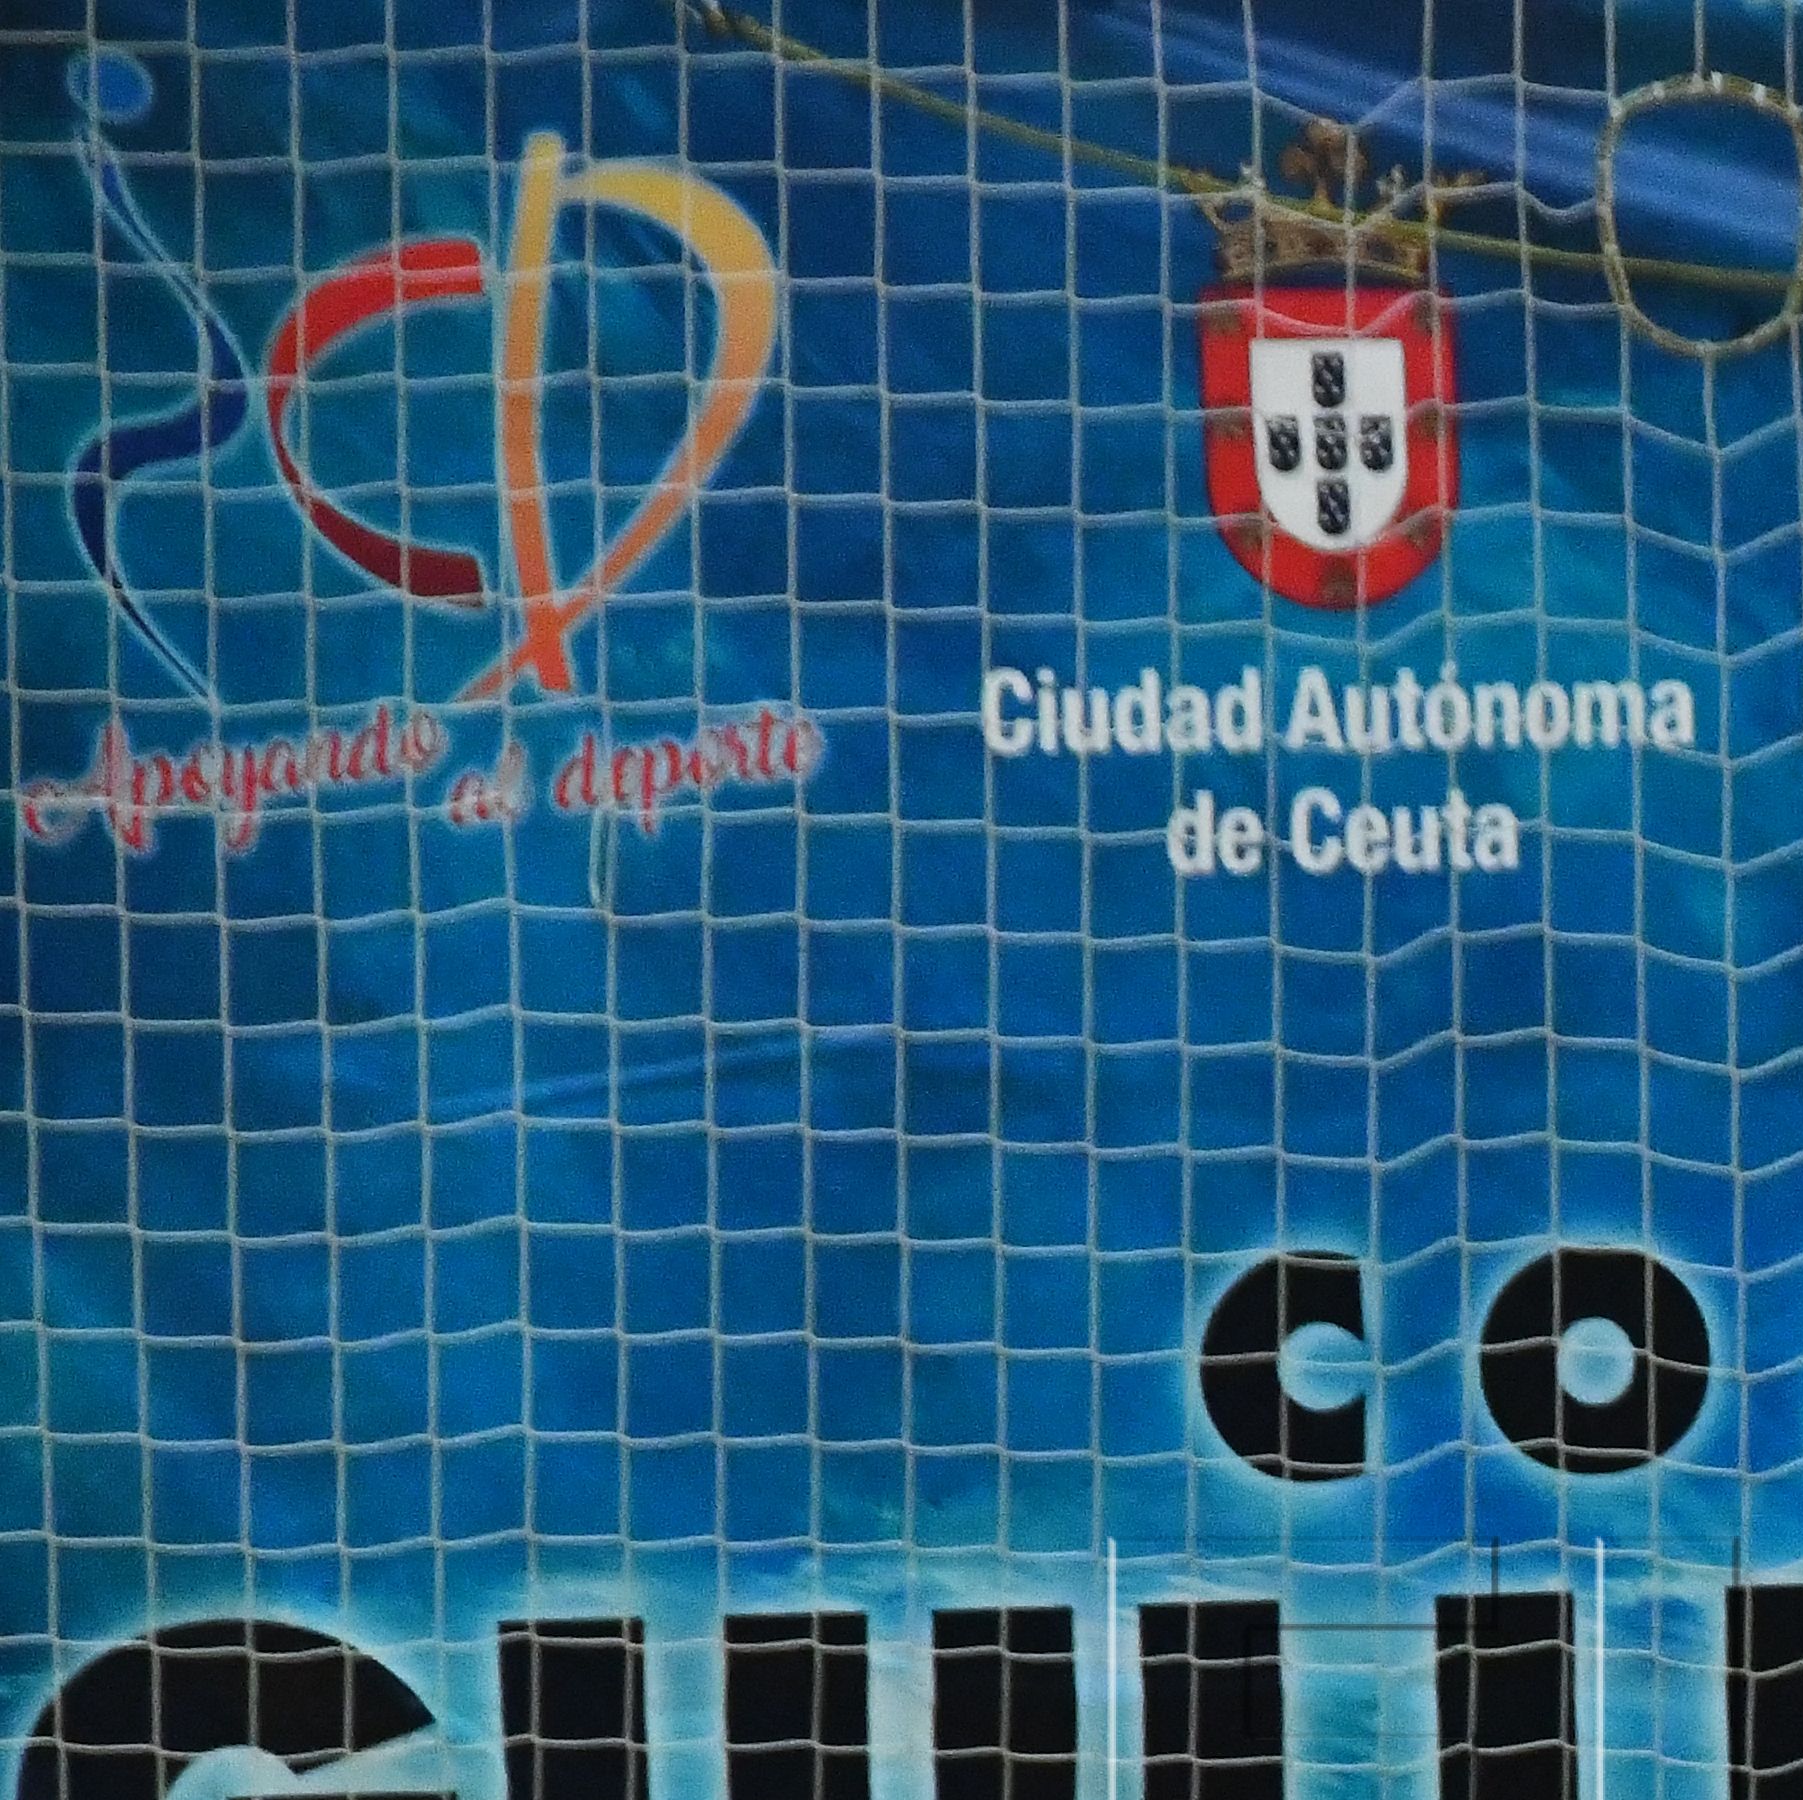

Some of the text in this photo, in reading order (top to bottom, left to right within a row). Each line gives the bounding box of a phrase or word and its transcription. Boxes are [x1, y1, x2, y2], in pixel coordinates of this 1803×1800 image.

[982, 661, 1694, 756] Ciudad Autónoma
[554, 708, 819, 835] deporte
[1167, 786, 1520, 875] de Ceuta
